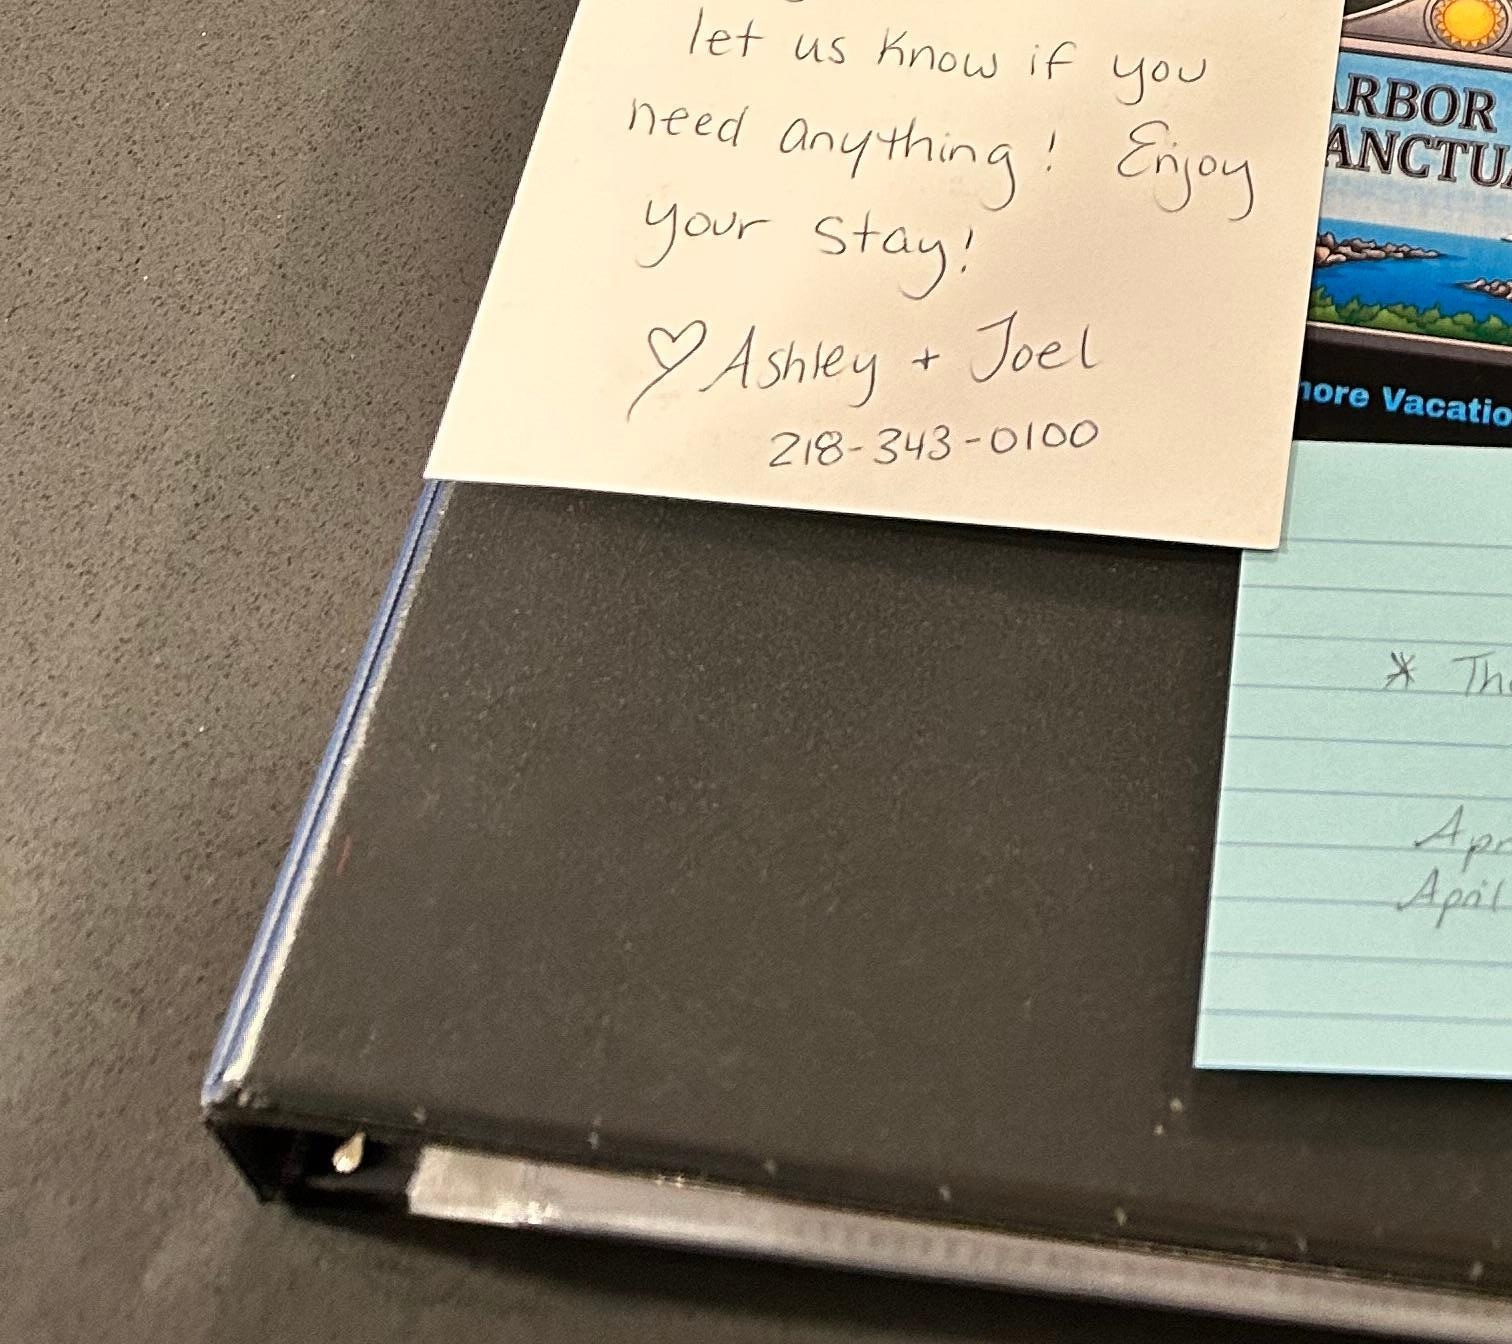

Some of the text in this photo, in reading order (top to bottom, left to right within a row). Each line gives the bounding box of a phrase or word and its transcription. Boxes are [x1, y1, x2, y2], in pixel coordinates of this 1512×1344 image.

[690, 7, 765, 60] let
[794, 32, 848, 67] us
[1030, 40, 1079, 81] if
[1112, 57, 1208, 107] you
[1332, 72, 1499, 134] RBOR
[627, 97, 750, 149] need
[1116, 120, 1256, 223] Enjoy
[634, 198, 770, 270] your
[698, 324, 880, 409] Ashley
[971, 310, 1100, 385] Joel
[769, 418, 1100, 469] 218-343-0100
[1396, 866, 1505, 930] April
